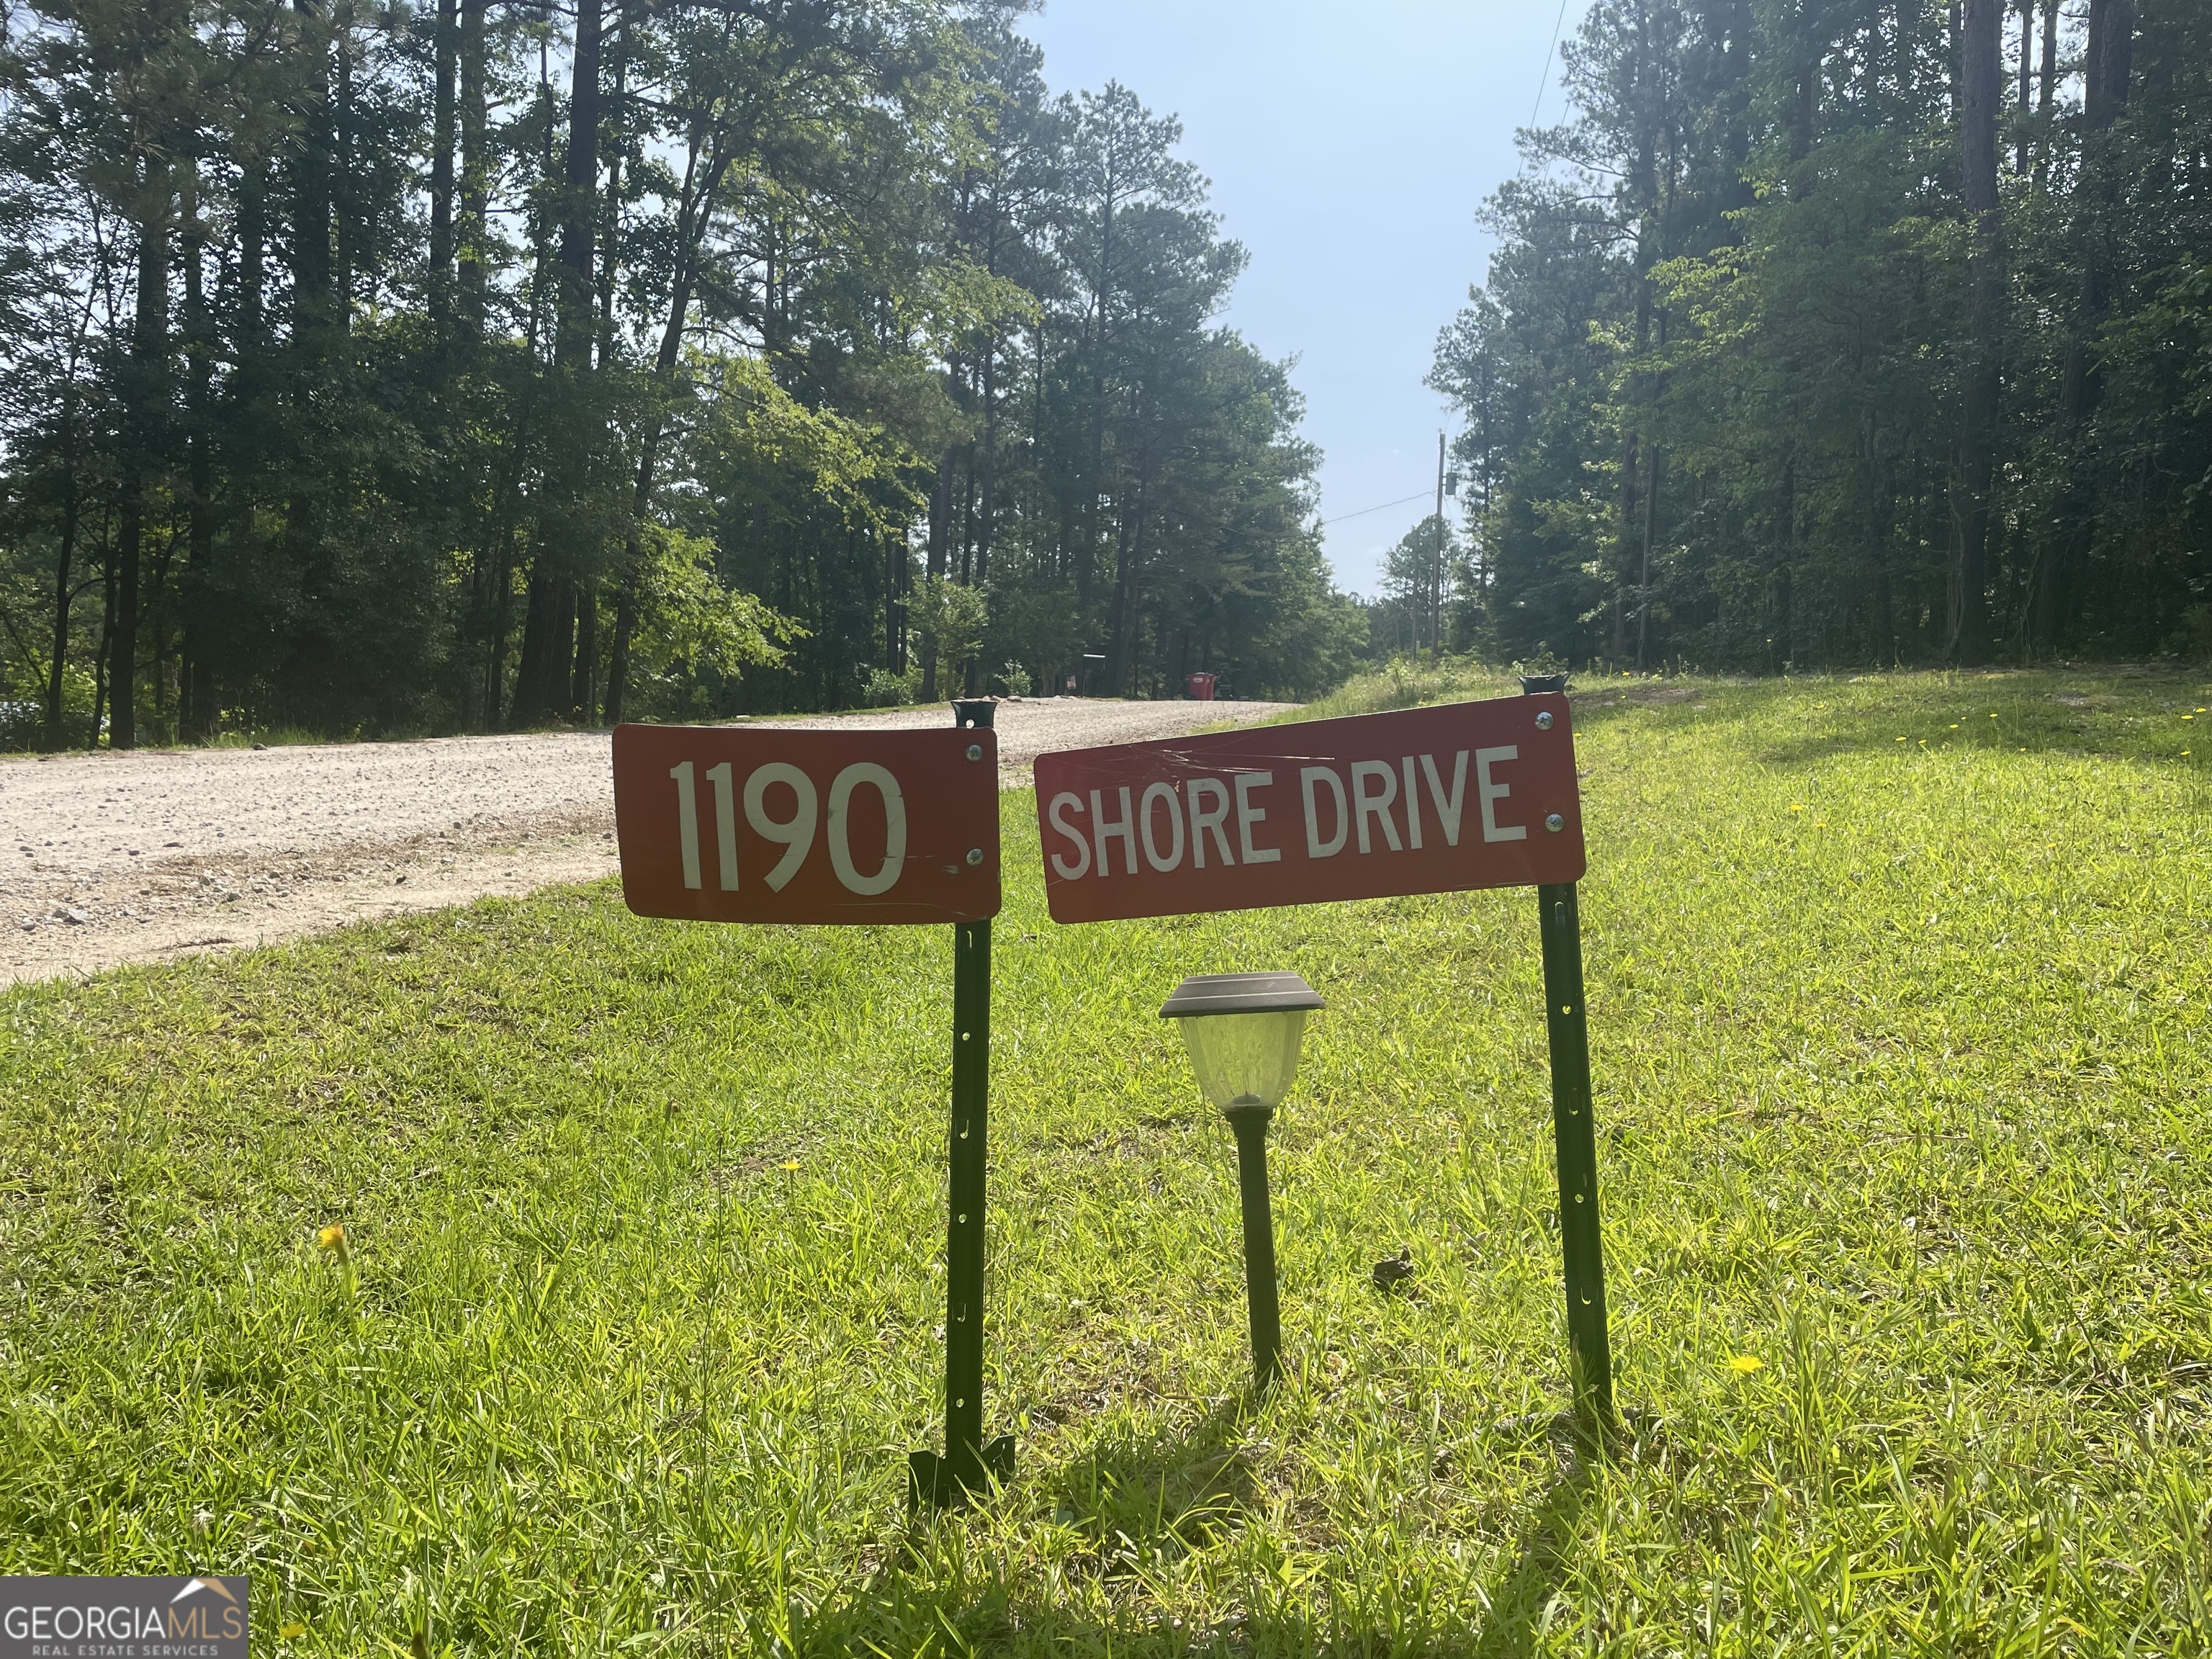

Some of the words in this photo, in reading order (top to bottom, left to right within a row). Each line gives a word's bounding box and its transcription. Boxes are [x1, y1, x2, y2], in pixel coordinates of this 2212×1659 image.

[670, 761, 907, 896] 1190
[1048, 771, 1282, 881] SHORE
[1300, 745, 1527, 858] DRIVE
